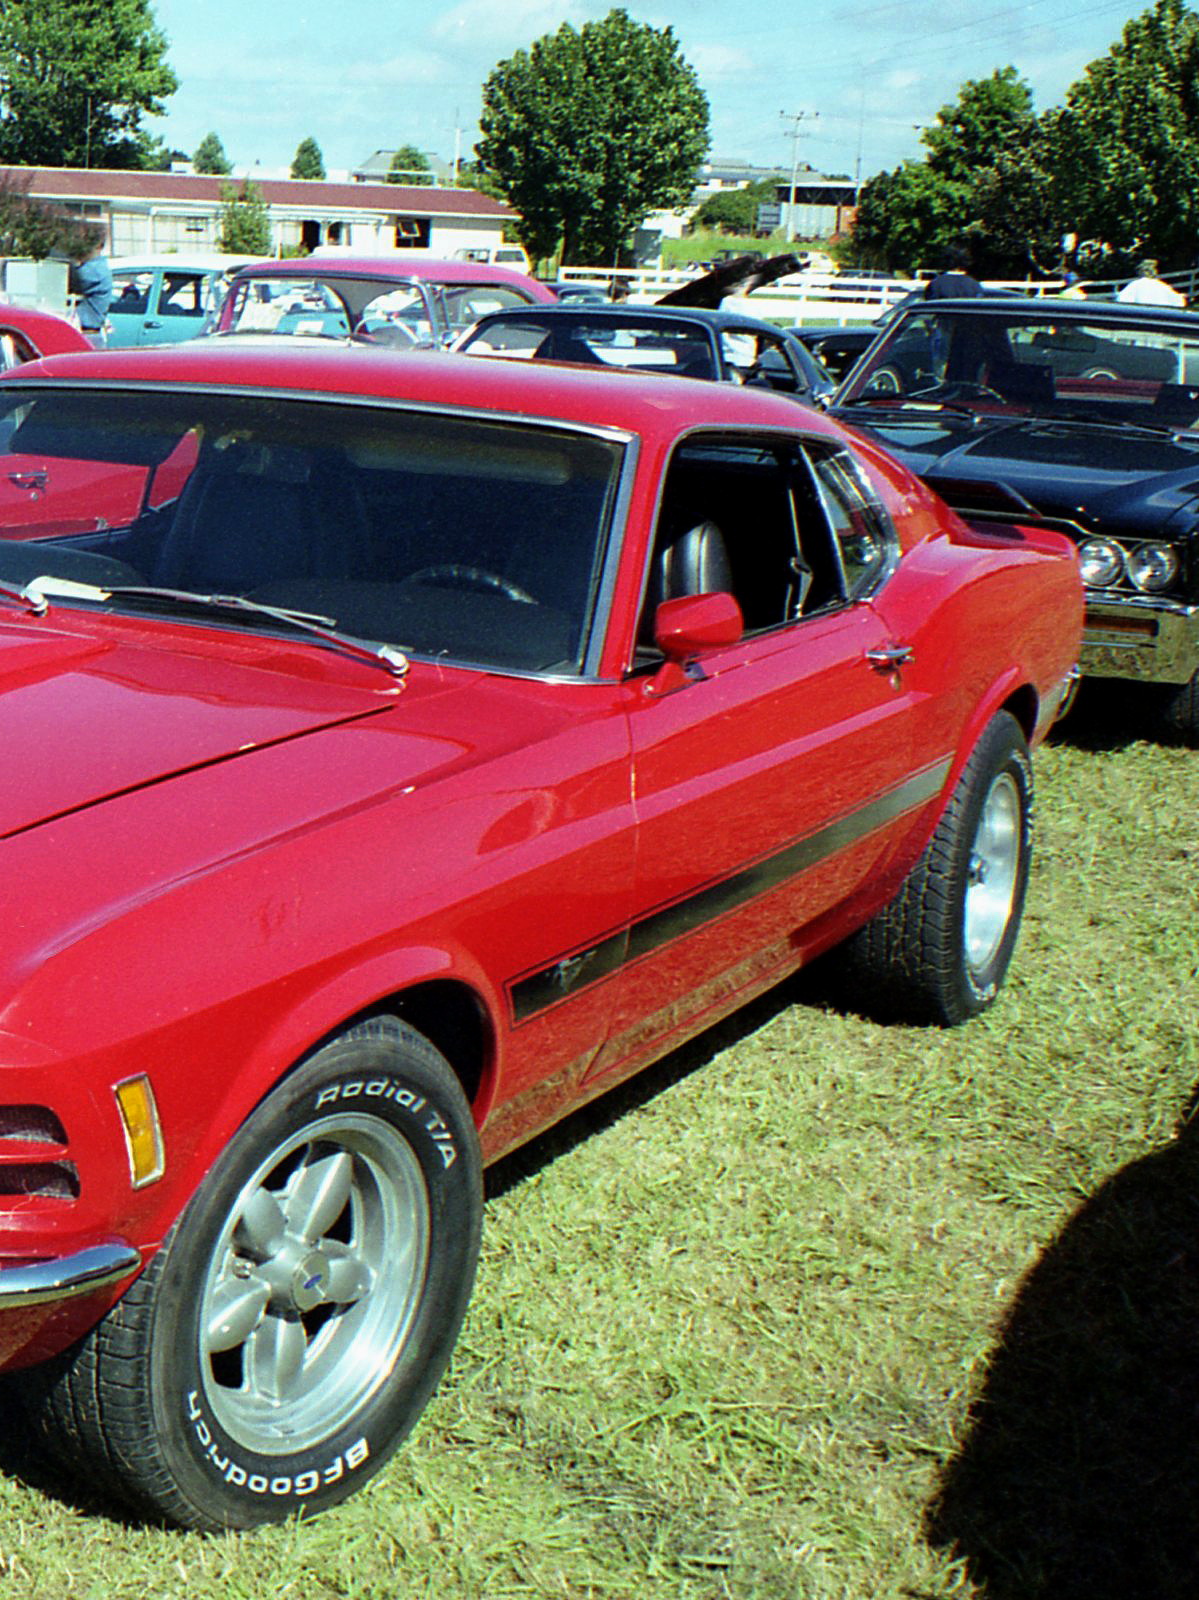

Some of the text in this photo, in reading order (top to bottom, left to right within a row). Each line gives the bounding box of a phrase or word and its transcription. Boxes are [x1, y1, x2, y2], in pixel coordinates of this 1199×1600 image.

[314, 1077, 457, 1169] Radial T/A
[188, 1390, 370, 1495] BFGoodrich
